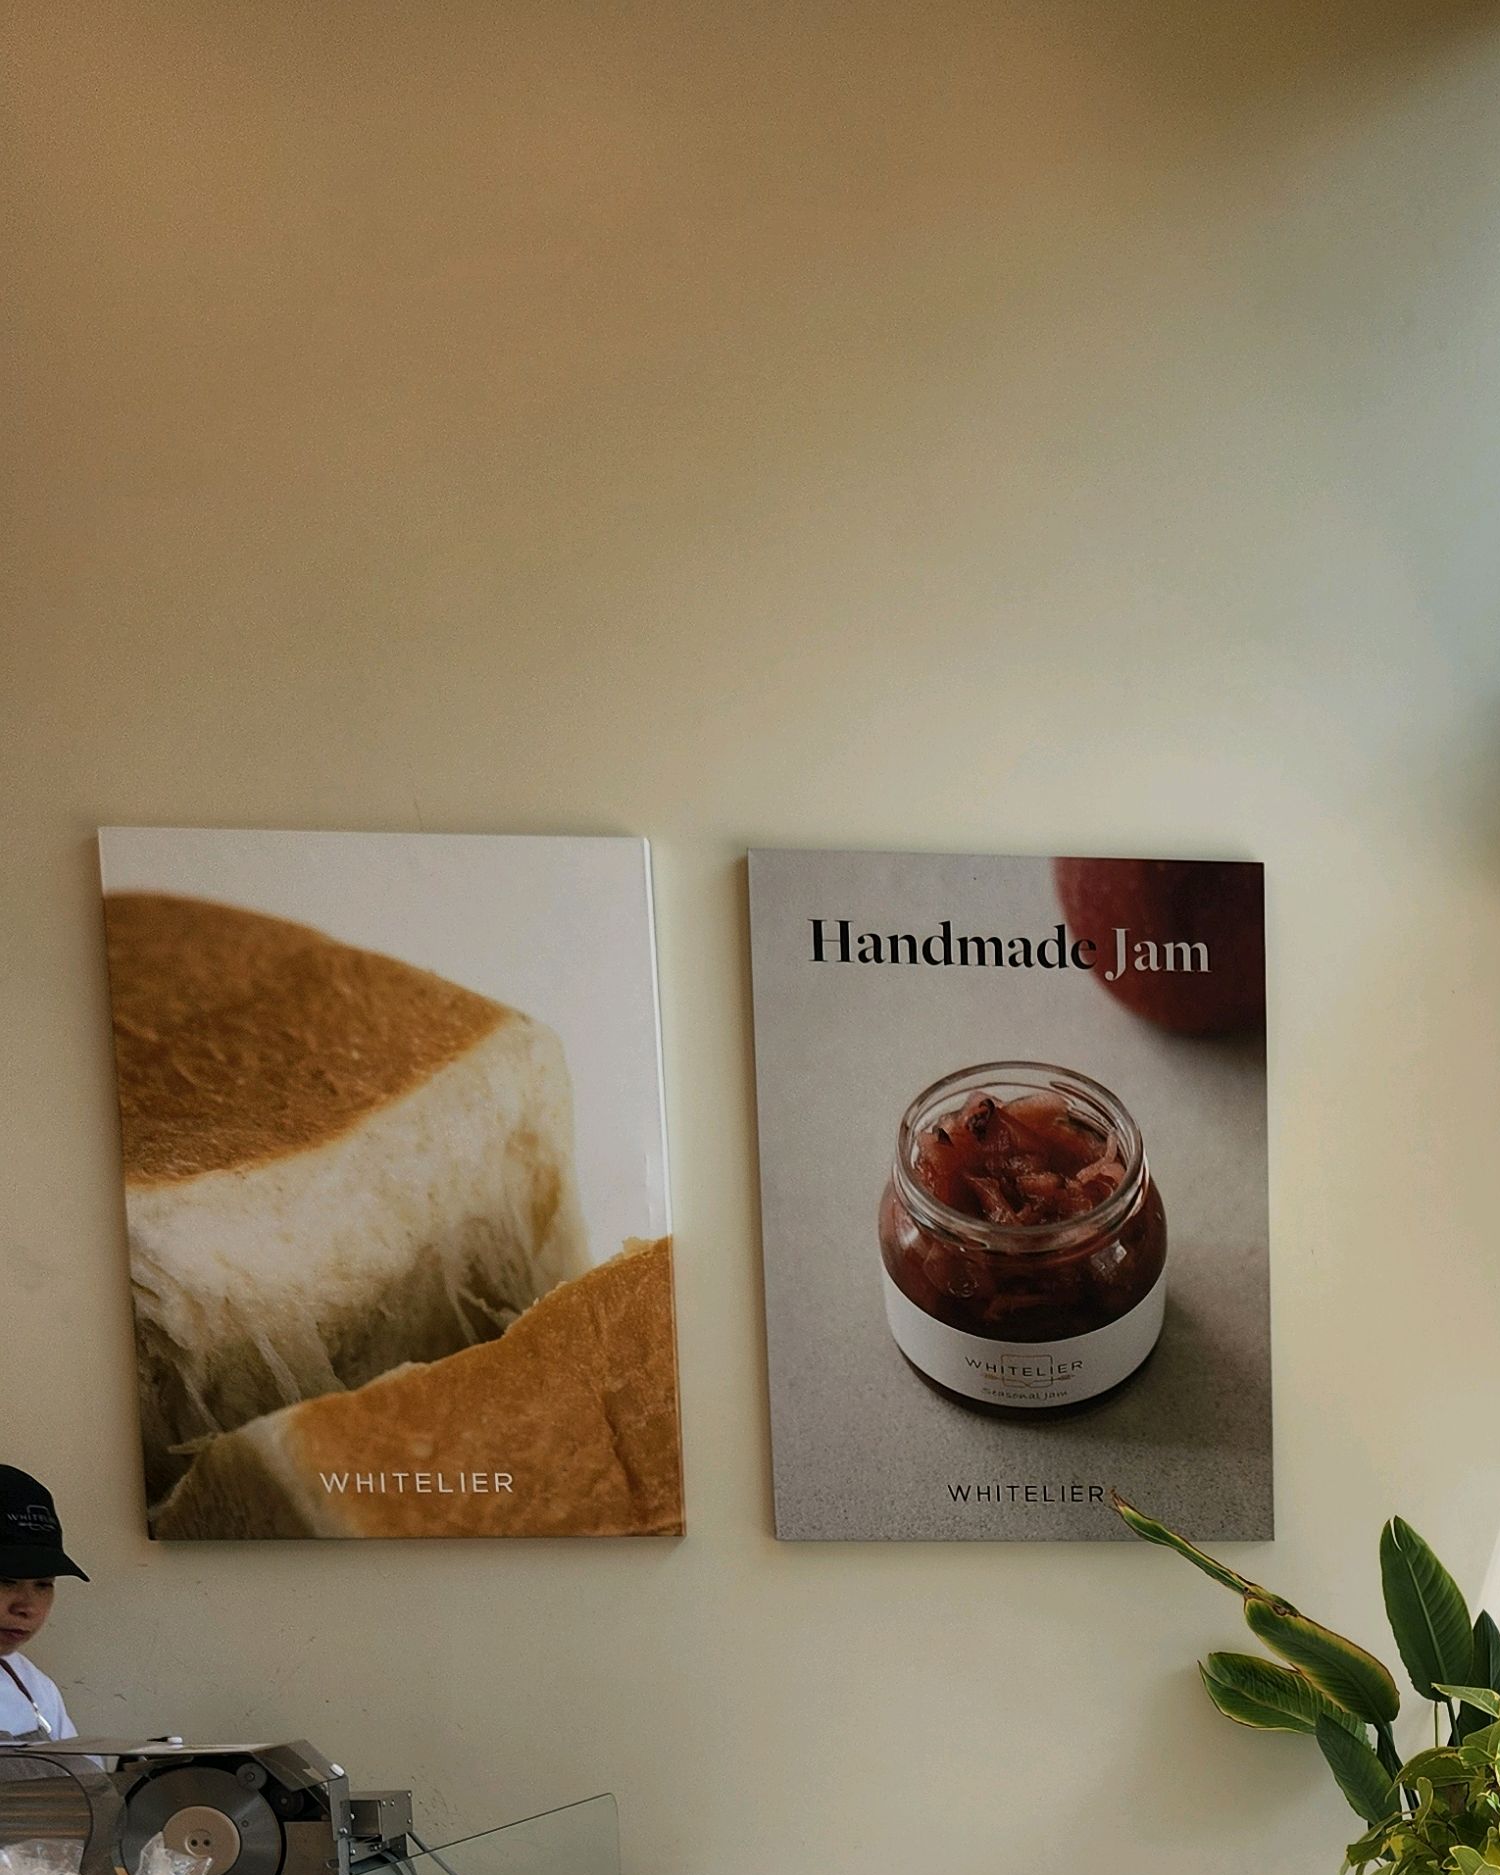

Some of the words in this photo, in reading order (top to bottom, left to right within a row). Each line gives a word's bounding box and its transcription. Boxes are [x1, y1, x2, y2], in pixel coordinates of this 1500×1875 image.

[807, 918, 1097, 970] Handmade
[1104, 927, 1213, 982] Jam
[964, 1356, 1084, 1377] WHITELIER
[319, 1472, 514, 1494] WHITELIER
[947, 1484, 1105, 1502] WHITELIER
